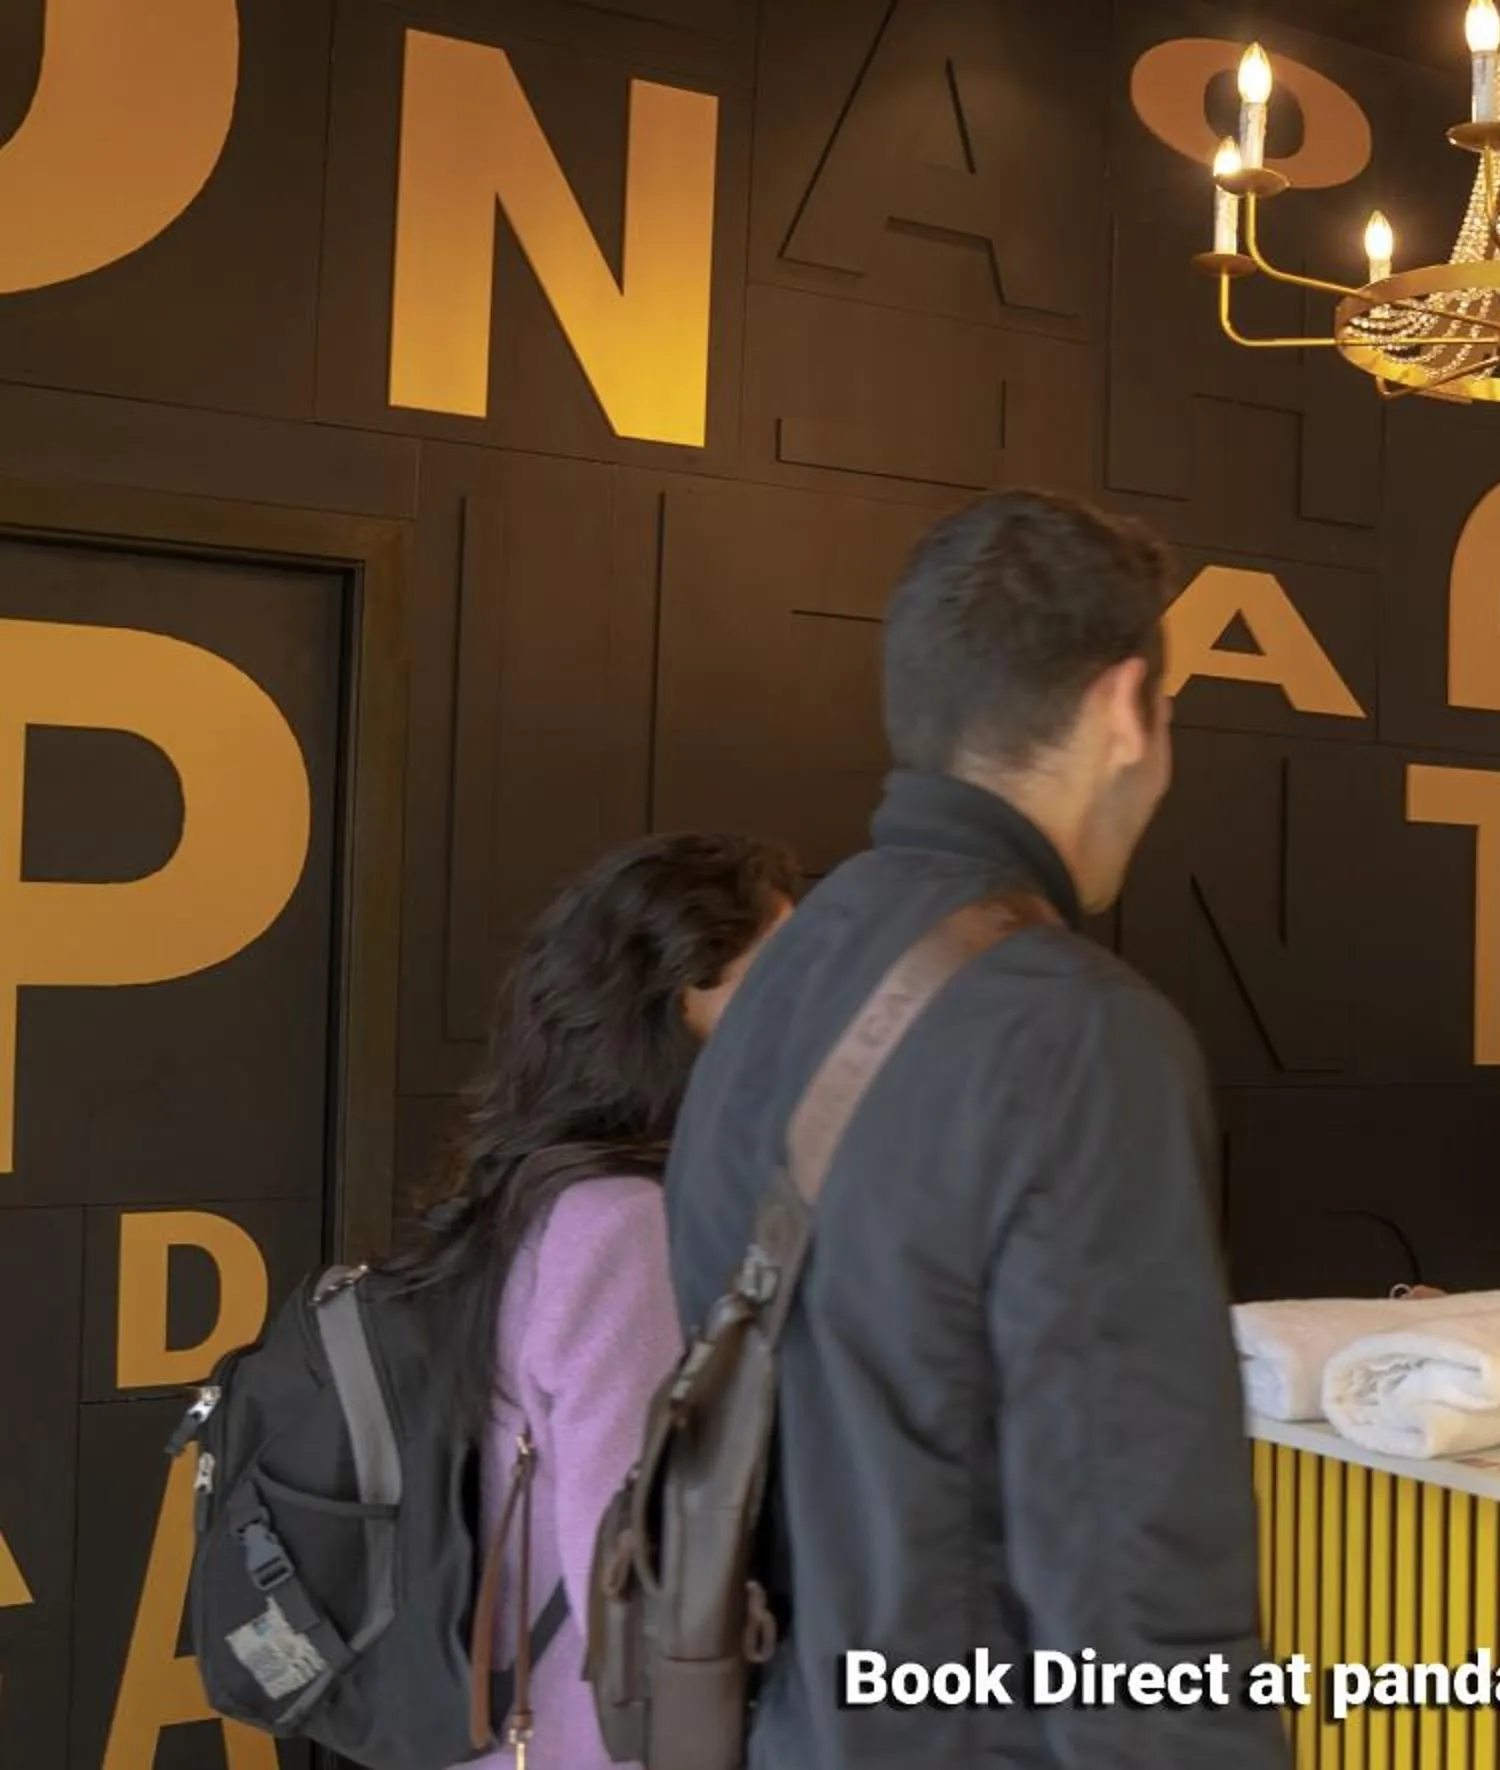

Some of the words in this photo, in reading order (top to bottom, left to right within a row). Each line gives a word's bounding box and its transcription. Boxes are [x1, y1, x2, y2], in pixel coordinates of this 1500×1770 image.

[1130, 37, 1373, 190] O
[388, 27, 719, 448] N
[1163, 564, 1368, 719] A
[0, 617, 311, 1174] P
[116, 1209, 269, 1389] D
